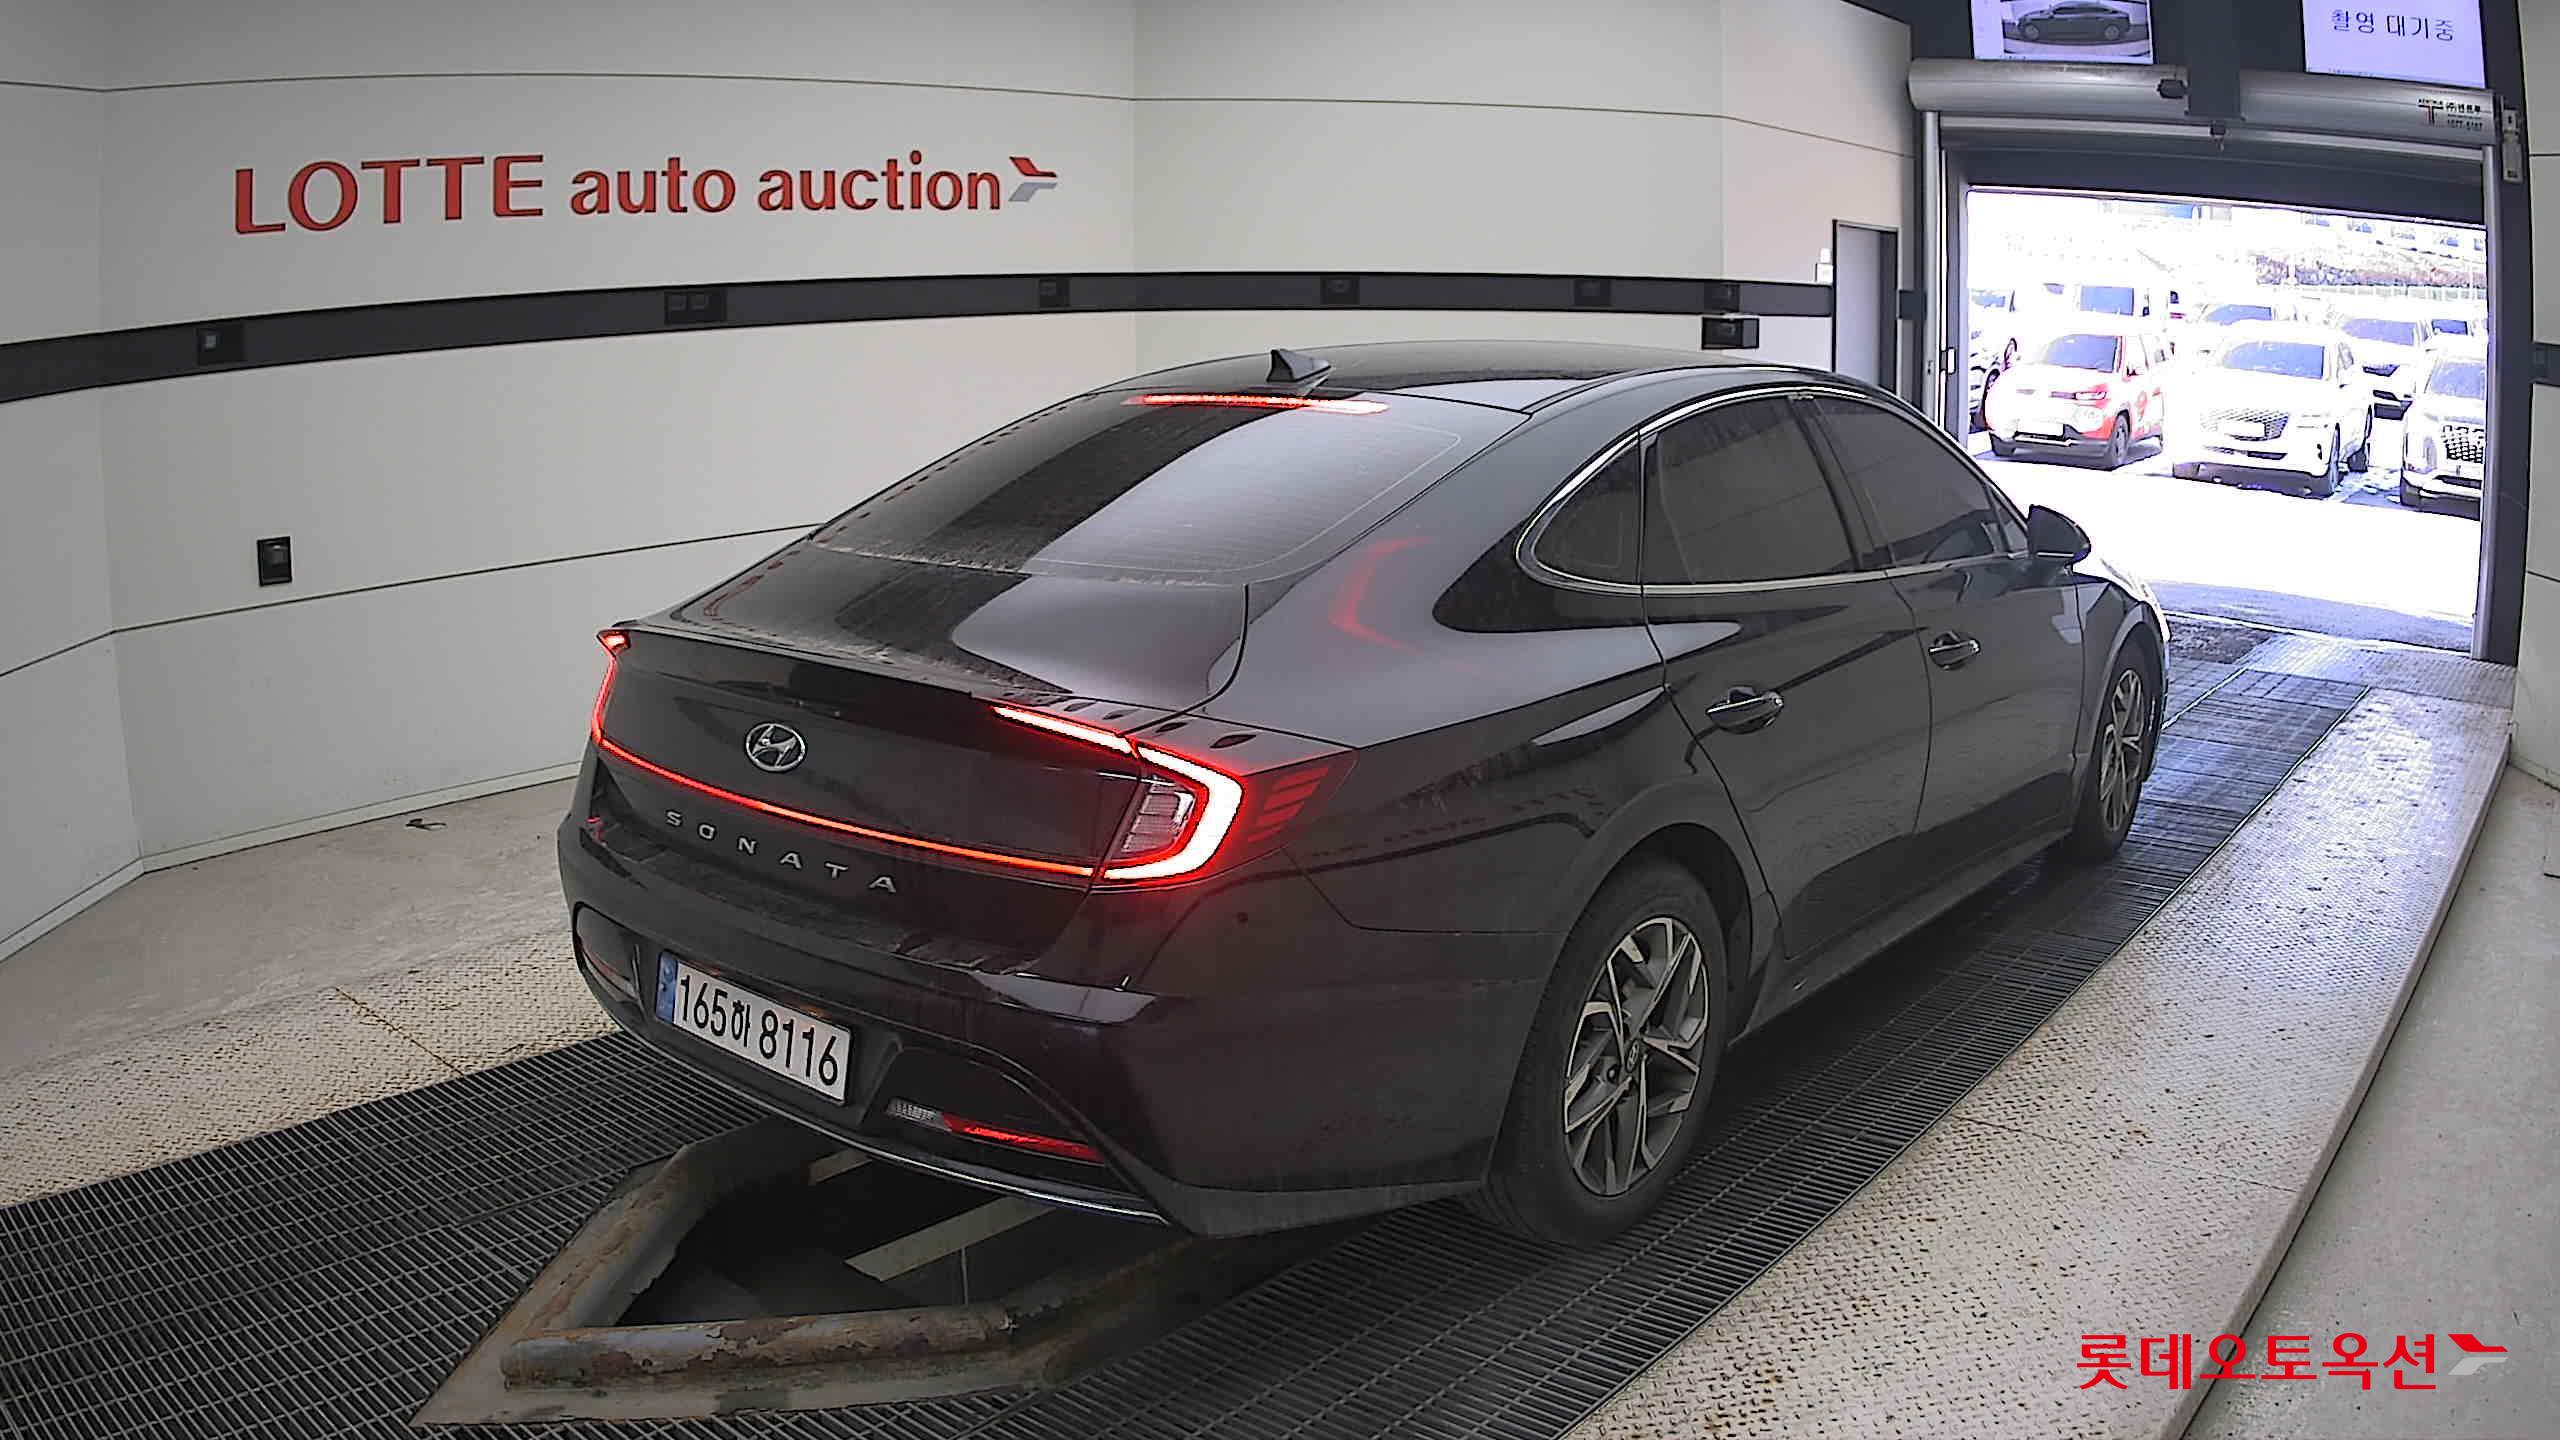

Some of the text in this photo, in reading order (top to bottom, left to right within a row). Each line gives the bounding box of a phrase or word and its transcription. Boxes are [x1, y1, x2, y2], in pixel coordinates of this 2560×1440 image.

[2331, 9, 2454, 41] 촬영 대기중
[235, 150, 1002, 234] LOTTE auto auction
[666, 810, 897, 893] SONATA
[680, 974, 838, 1086] 165하 8116
